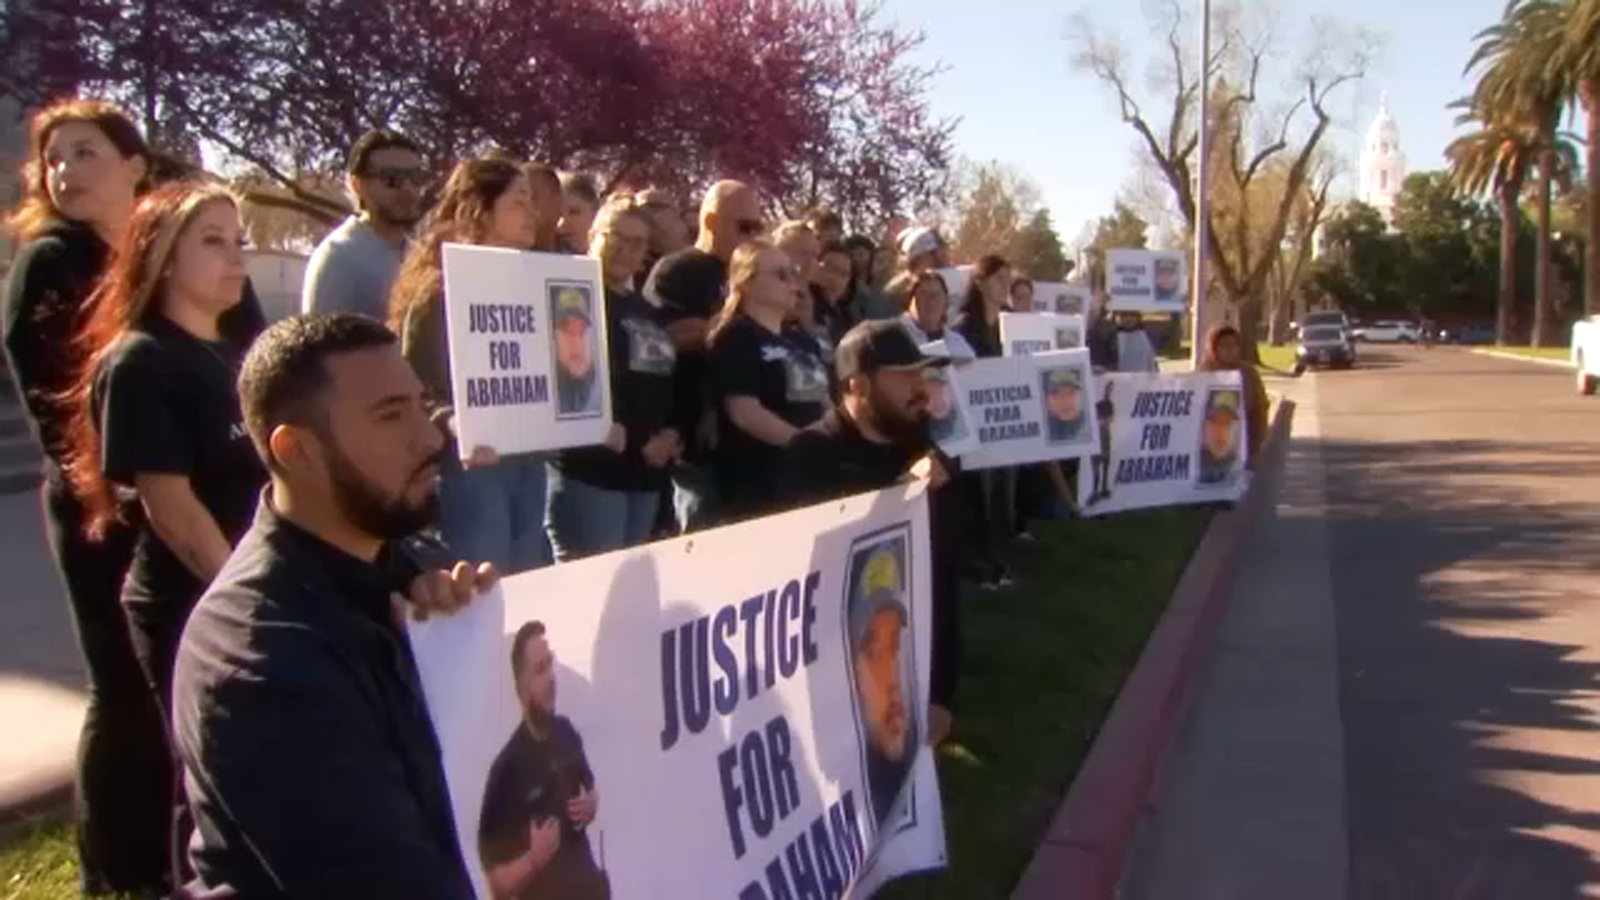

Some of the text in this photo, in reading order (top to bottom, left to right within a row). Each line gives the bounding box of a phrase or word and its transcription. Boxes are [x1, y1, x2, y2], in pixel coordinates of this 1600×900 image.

[469, 304, 535, 333] JUSTICE
[489, 341, 521, 370] FOR
[467, 375, 549, 407] ABRAHAM
[1130, 390, 1195, 418] JUSTICE
[1140, 423, 1171, 450] FOR
[1114, 453, 1190, 484] ABRAHAM
[661, 570, 820, 751] JUSTICE
[717, 715, 800, 860] FOR
